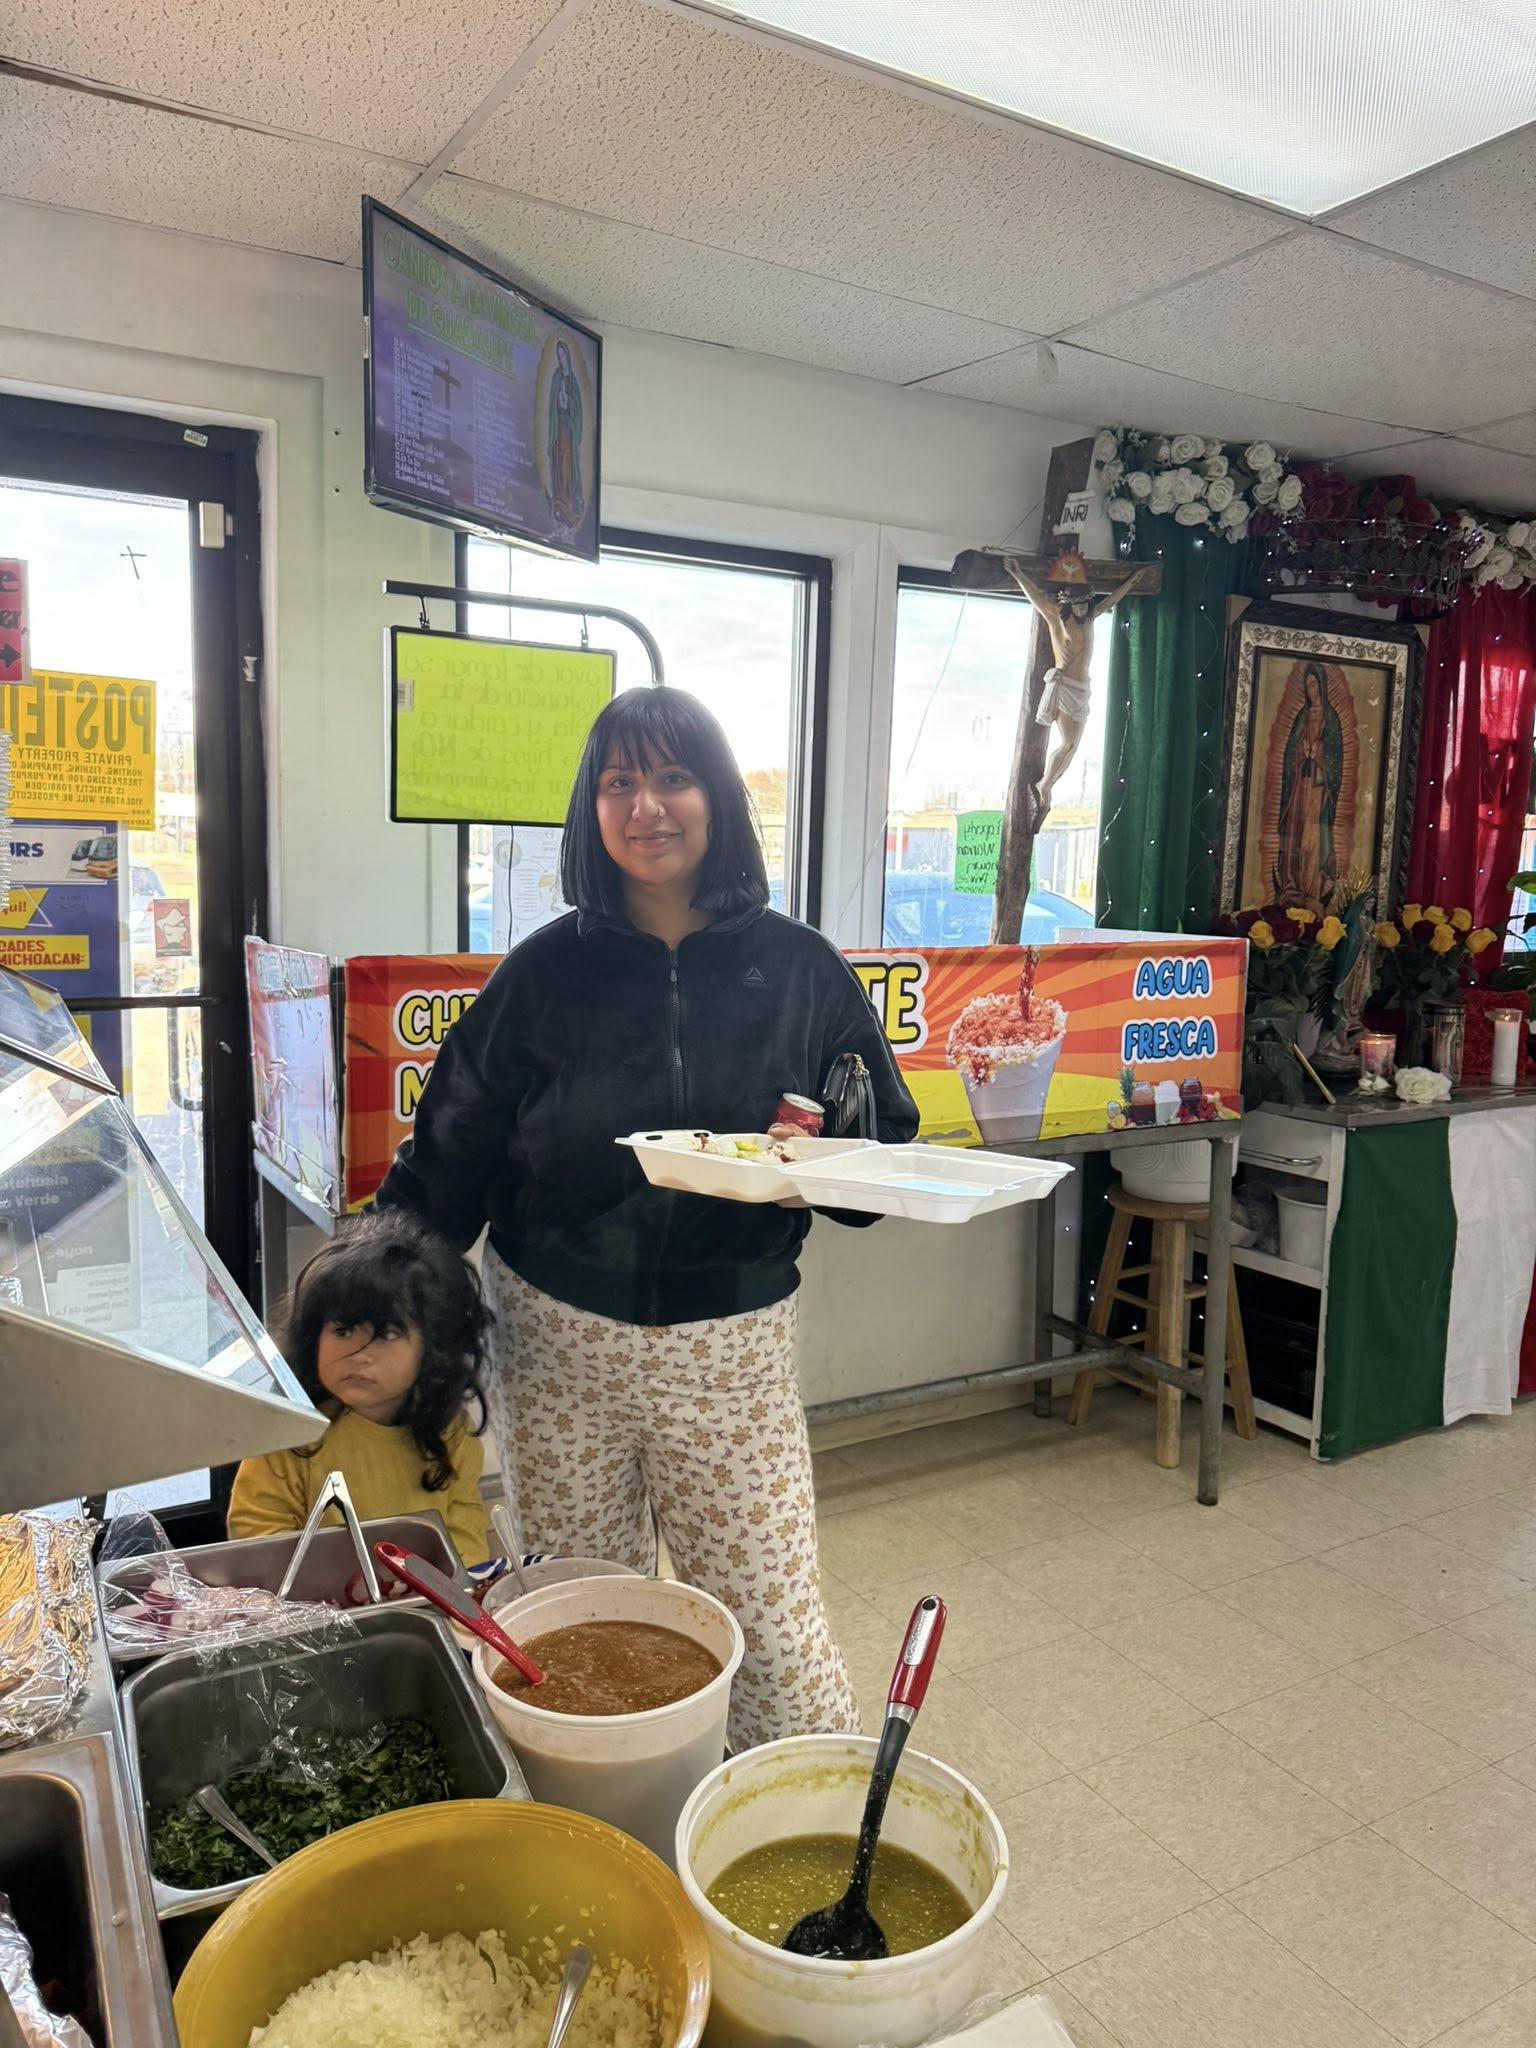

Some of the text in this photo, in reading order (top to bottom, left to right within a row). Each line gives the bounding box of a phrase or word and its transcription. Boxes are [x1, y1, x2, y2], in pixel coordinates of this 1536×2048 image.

[408, 290, 427, 324] DE
[431, 303, 514, 371] GUADALUPE
[453, 272, 463, 303] A
[467, 278, 481, 313] LA
[488, 292, 536, 345] VIRGEN
[1062, 503, 1089, 524] INRI
[1135, 959, 1209, 997] AGUA
[1124, 1018, 1216, 1062] FRESCA
